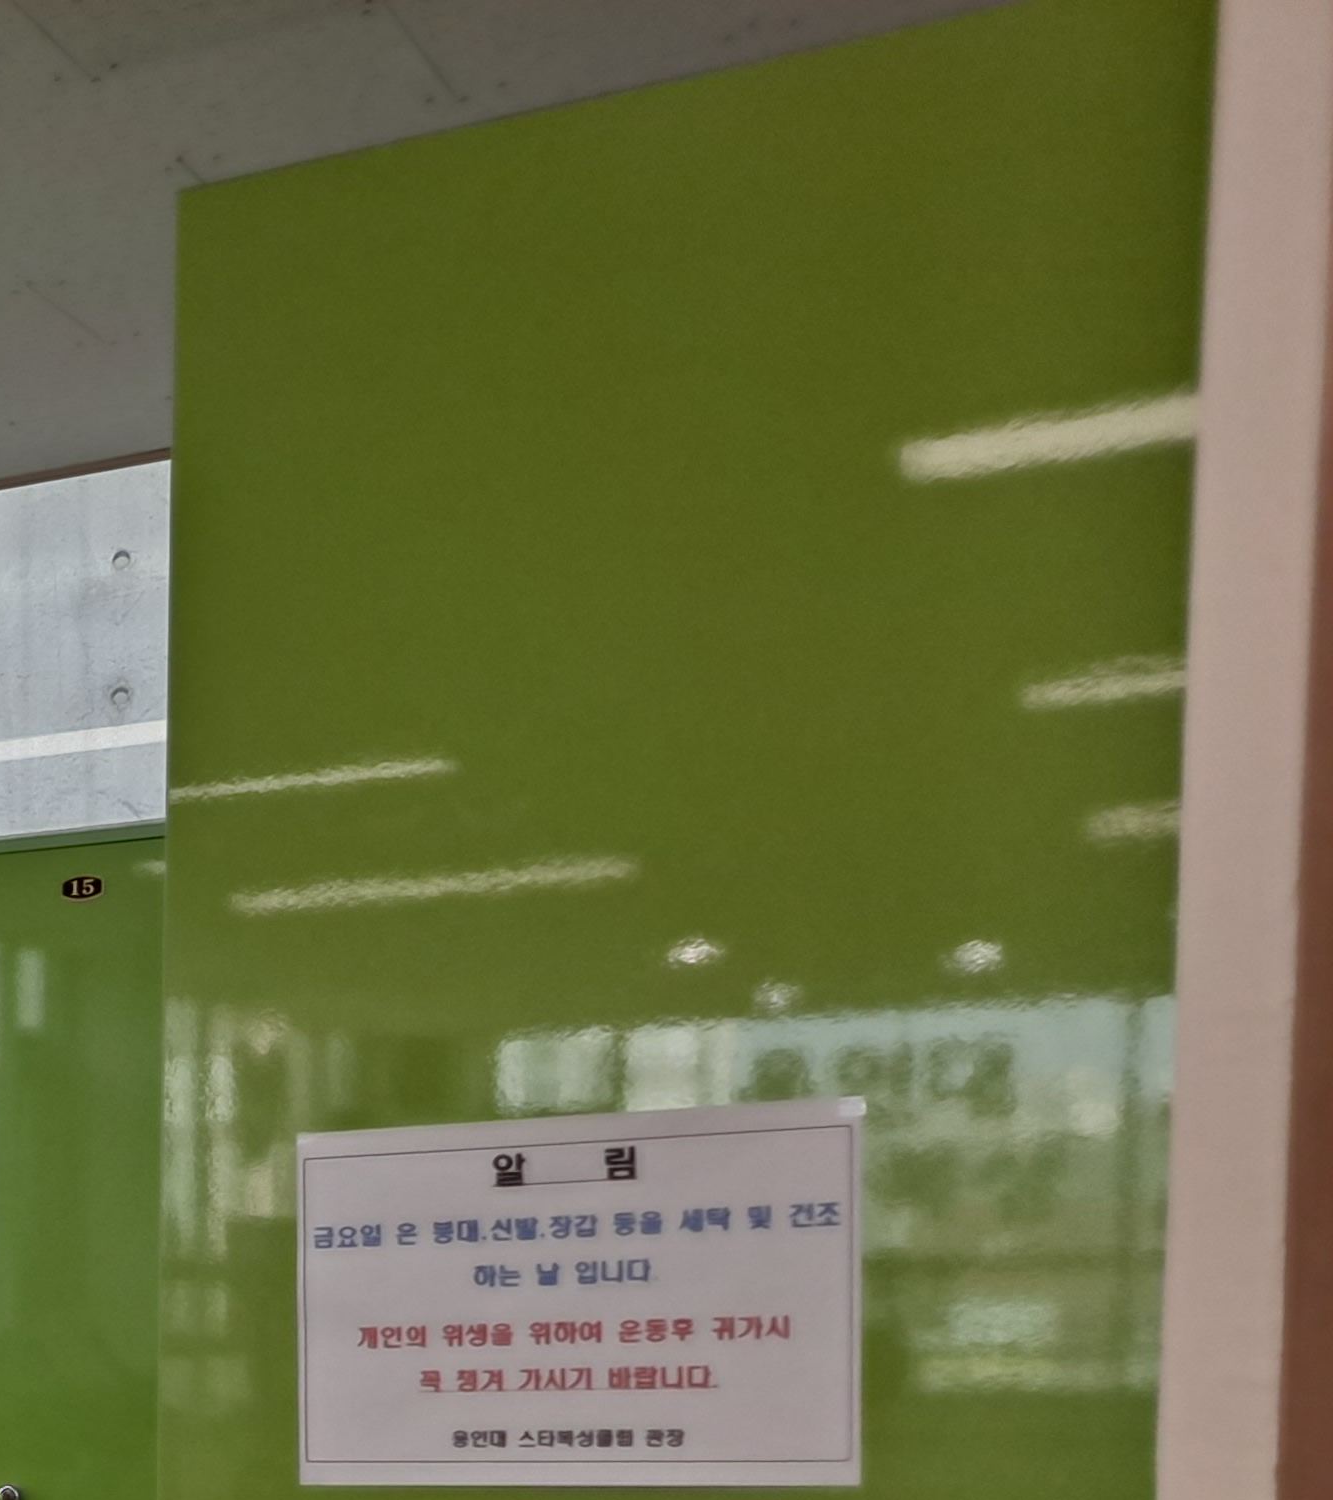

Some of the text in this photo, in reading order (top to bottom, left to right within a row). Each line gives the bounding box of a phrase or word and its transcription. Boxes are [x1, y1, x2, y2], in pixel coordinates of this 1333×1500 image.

[71, 879, 94, 896] 15
[313, 1224, 382, 1249] 금요일
[396, 1222, 417, 1246] 은
[679, 1206, 731, 1233] 세탁
[746, 1204, 772, 1230] 및
[788, 1201, 841, 1229] 건조
[473, 1264, 521, 1288] 하는
[536, 1262, 560, 1286] 날
[357, 1314, 790, 1349] 개인의 위생을 위하여 운동후 귀가시
[519, 1367, 593, 1391] 가시기
[451, 1429, 507, 1448] 용인대
